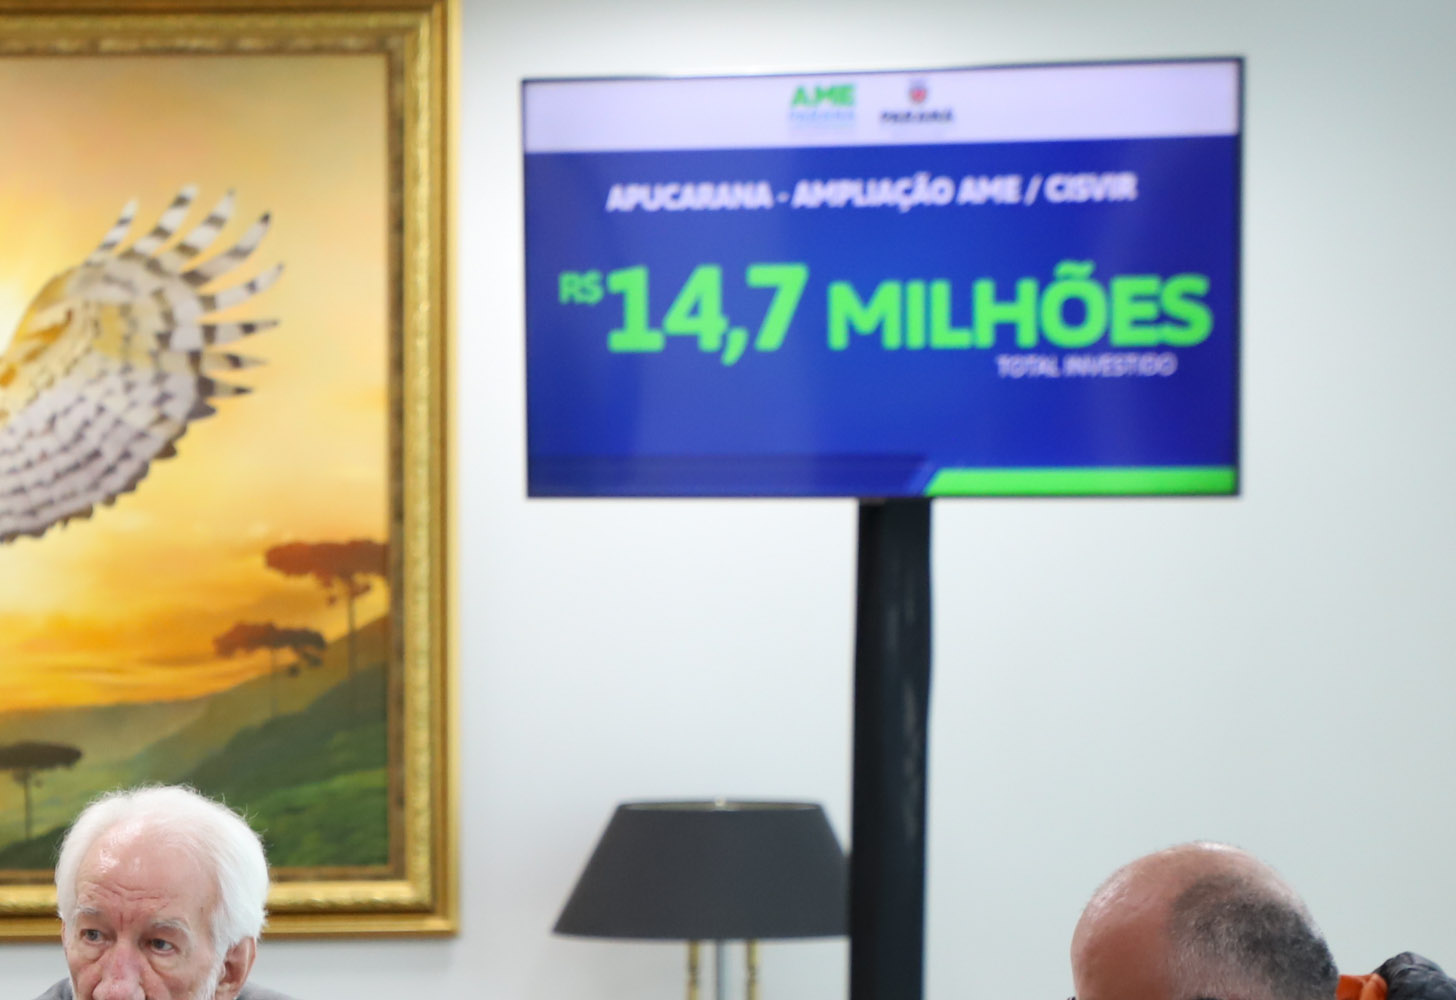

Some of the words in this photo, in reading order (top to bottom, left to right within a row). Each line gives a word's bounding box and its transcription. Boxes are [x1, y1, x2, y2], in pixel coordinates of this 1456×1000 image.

[791, 84, 856, 106] AME
[606, 182, 774, 211] APUCARANA
[792, 171, 955, 213] AMPLIAÇÃO
[957, 174, 1023, 205] AME
[1044, 171, 1139, 203] CISVIR
[558, 271, 604, 305] R$
[605, 262, 810, 366] 14,7
[826, 259, 1215, 350] MILHÕES
[996, 353, 1059, 378] TOTAL
